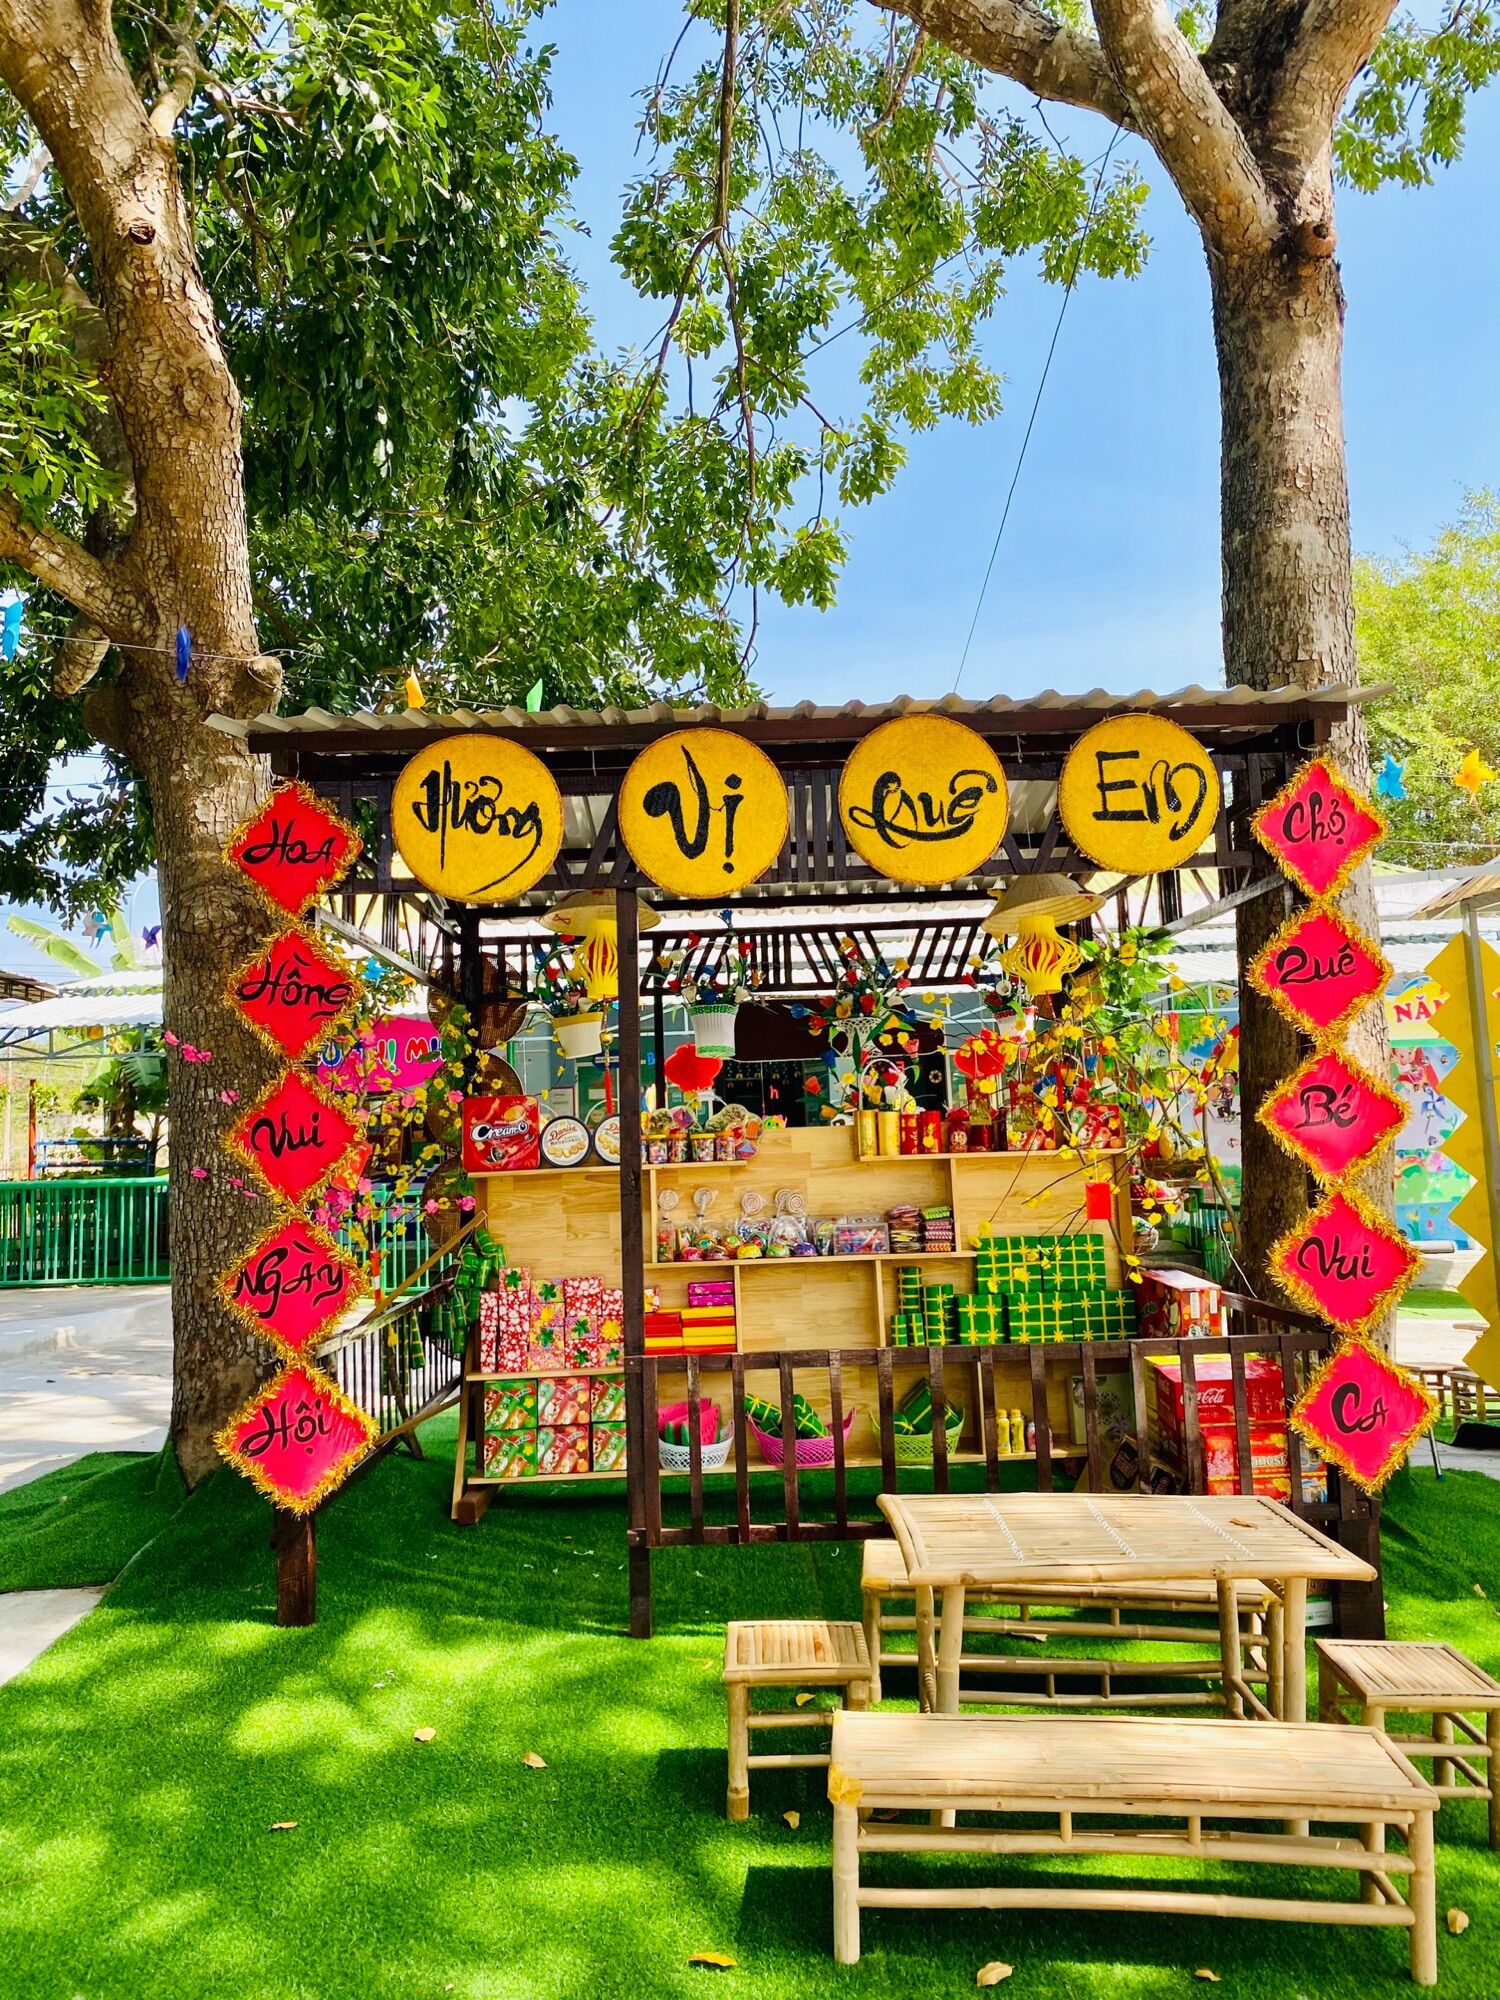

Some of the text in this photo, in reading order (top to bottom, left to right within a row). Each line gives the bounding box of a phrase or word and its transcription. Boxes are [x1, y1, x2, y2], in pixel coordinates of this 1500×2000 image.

[412, 744, 1208, 896] Hương Vị Quê Em
[1282, 791, 1347, 846] Chợ
[1275, 943, 1359, 985] Quê
[1393, 995, 1444, 1023] NĂ
[1294, 1083, 1358, 1129] Bé
[250, 1110, 325, 1159] Vui
[1297, 1236, 1376, 1281] Vui
[238, 1398, 333, 1456] Hội
